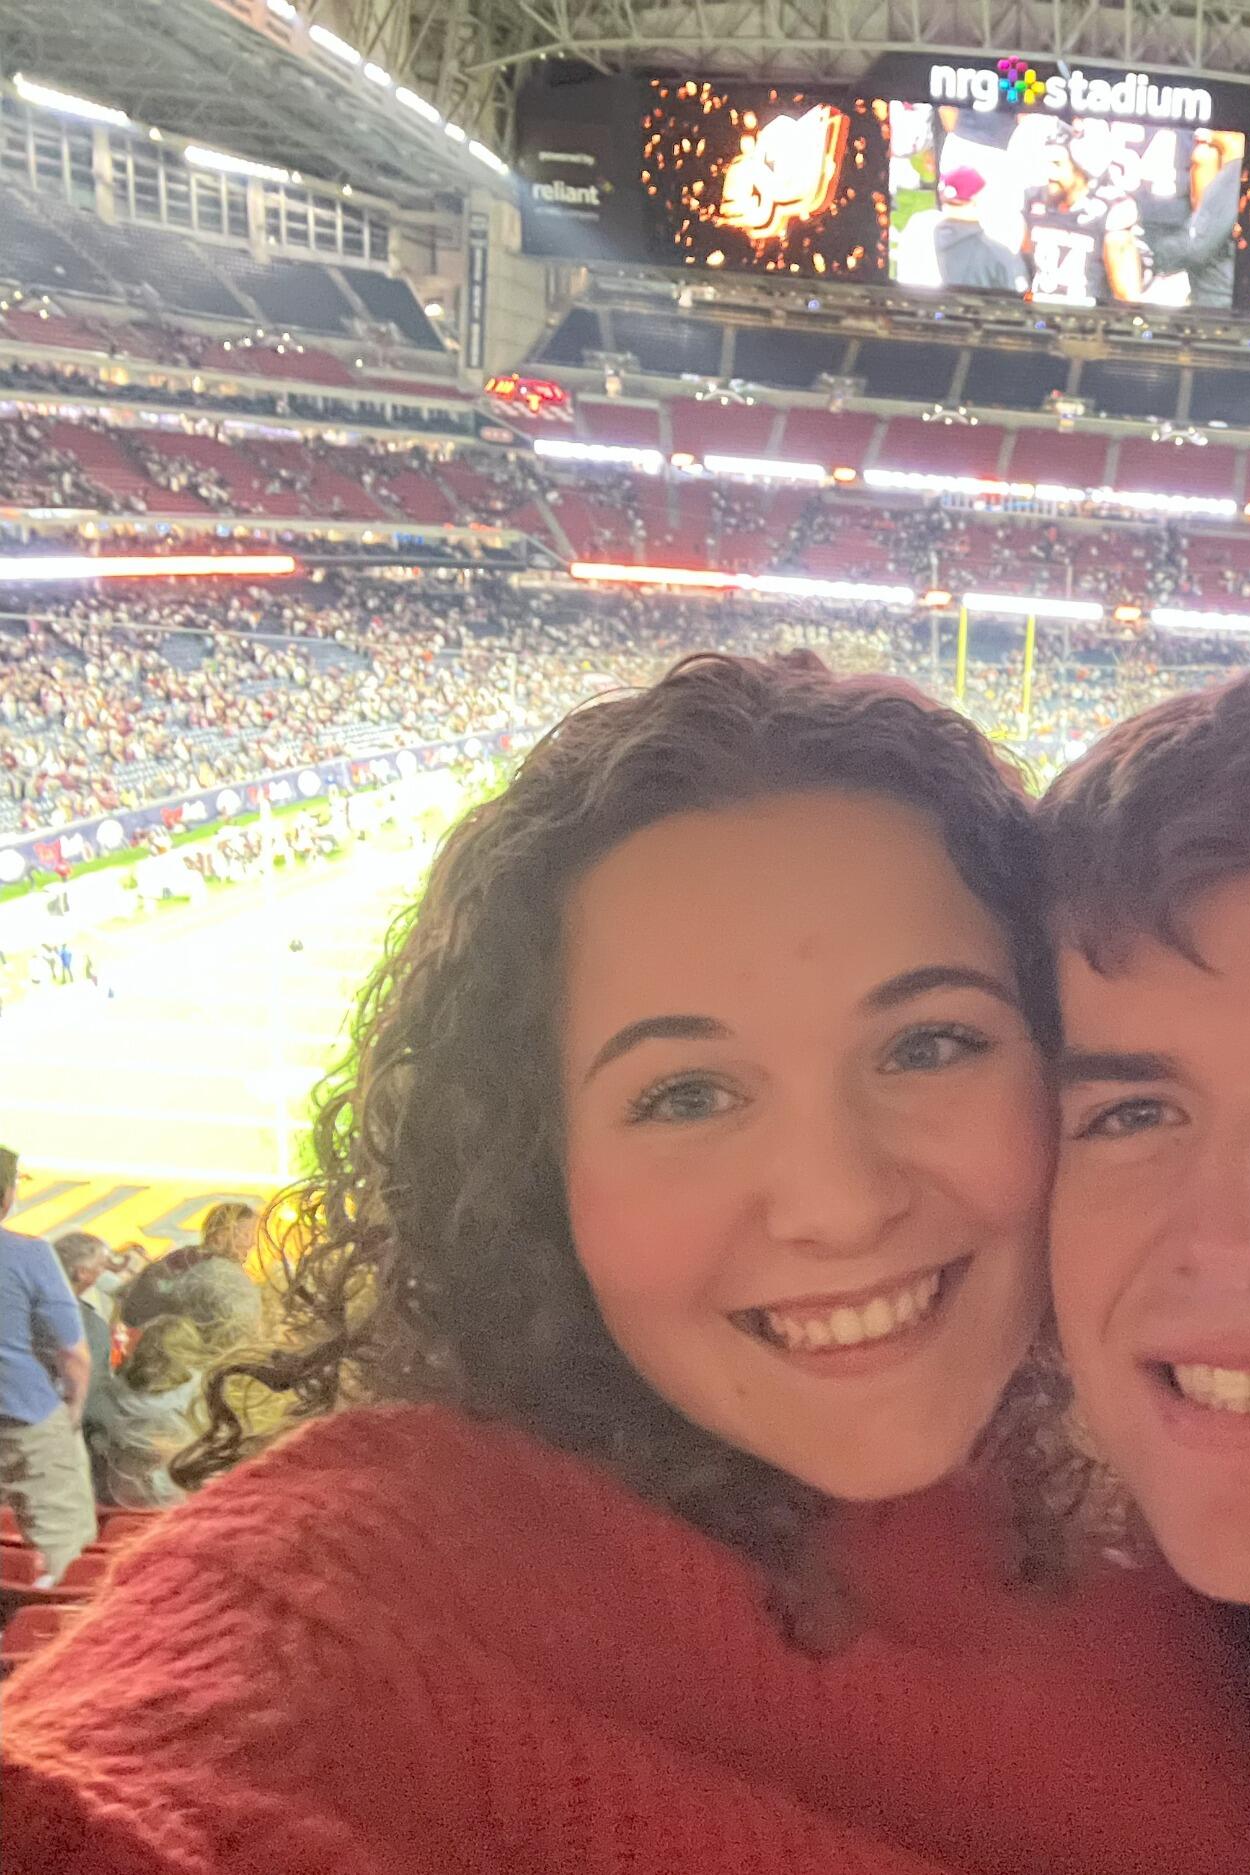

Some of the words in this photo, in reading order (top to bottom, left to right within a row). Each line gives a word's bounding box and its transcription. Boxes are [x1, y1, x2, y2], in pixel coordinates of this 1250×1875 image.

[929, 64, 999, 112] nrg
[1042, 69, 1213, 122] stadium
[532, 180, 600, 205] reliant
